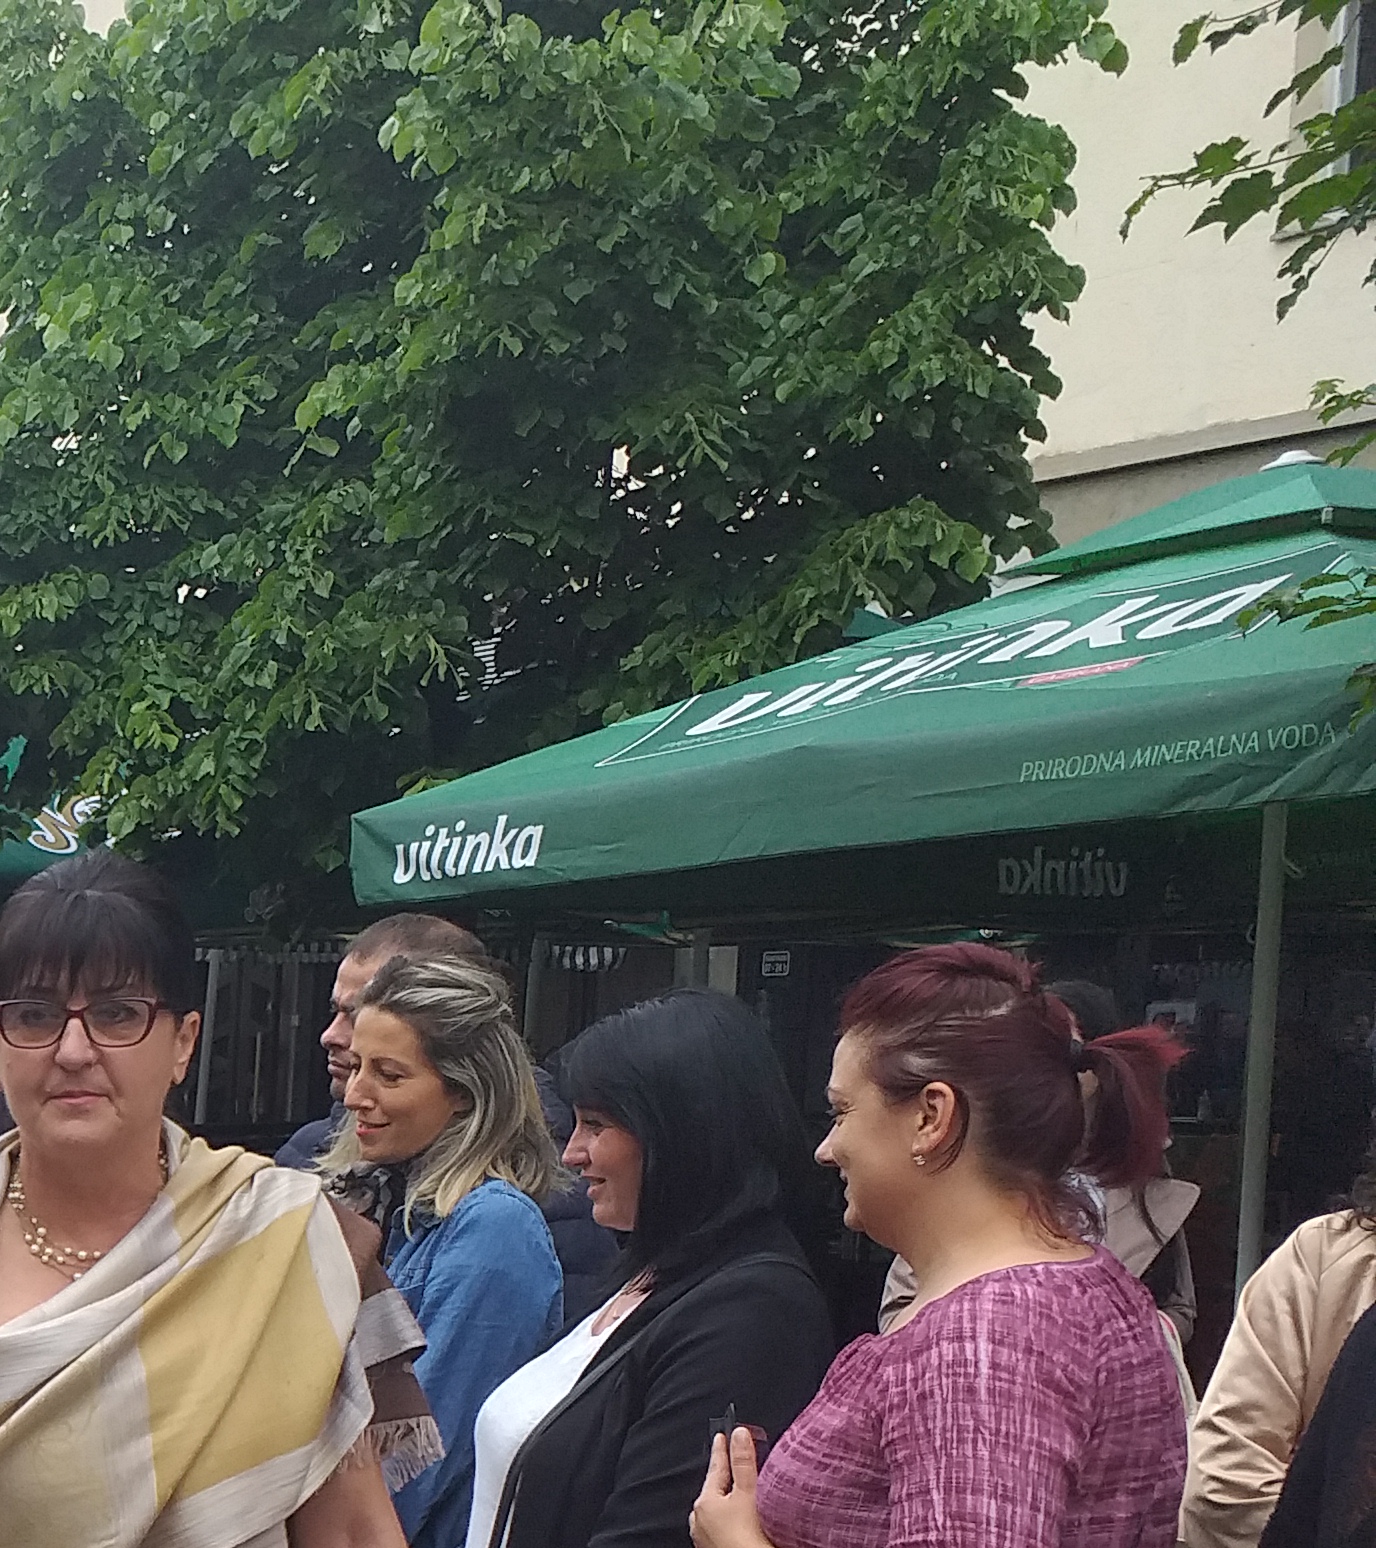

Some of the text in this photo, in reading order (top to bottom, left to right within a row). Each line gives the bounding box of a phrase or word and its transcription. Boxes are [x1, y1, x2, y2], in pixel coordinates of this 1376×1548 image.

[685, 573, 1294, 736] vitinka
[1020, 721, 1336, 783] PRIRODNA MINERALNA VODA
[393, 814, 545, 885] vitinka
